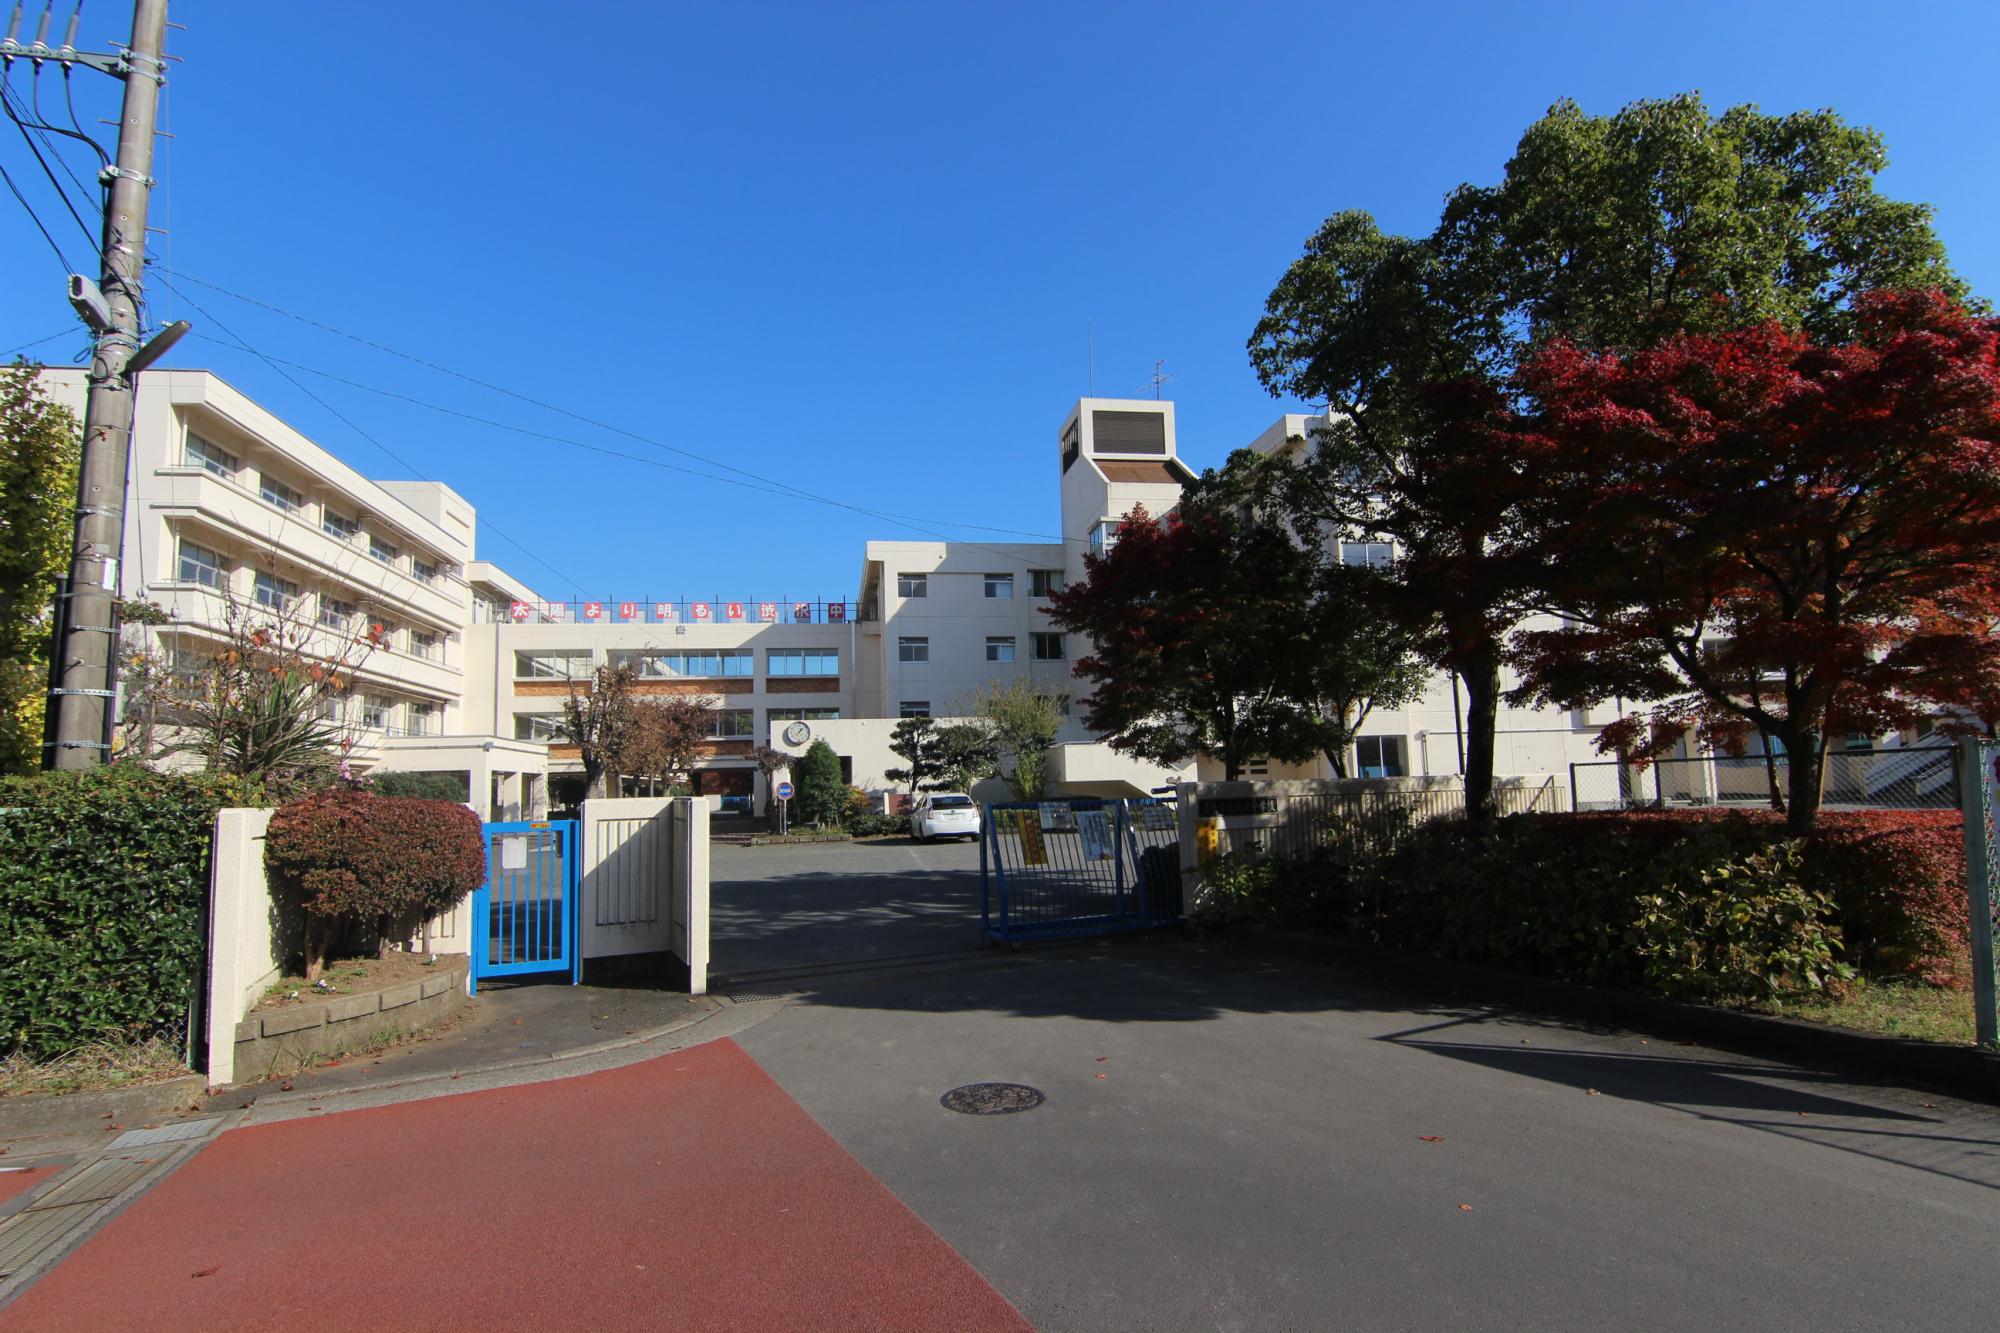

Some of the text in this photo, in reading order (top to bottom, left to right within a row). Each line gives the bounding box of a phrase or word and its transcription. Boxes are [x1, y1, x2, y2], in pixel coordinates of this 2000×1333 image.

[512, 602, 843, 618] 太陽より明るい渋沢中
